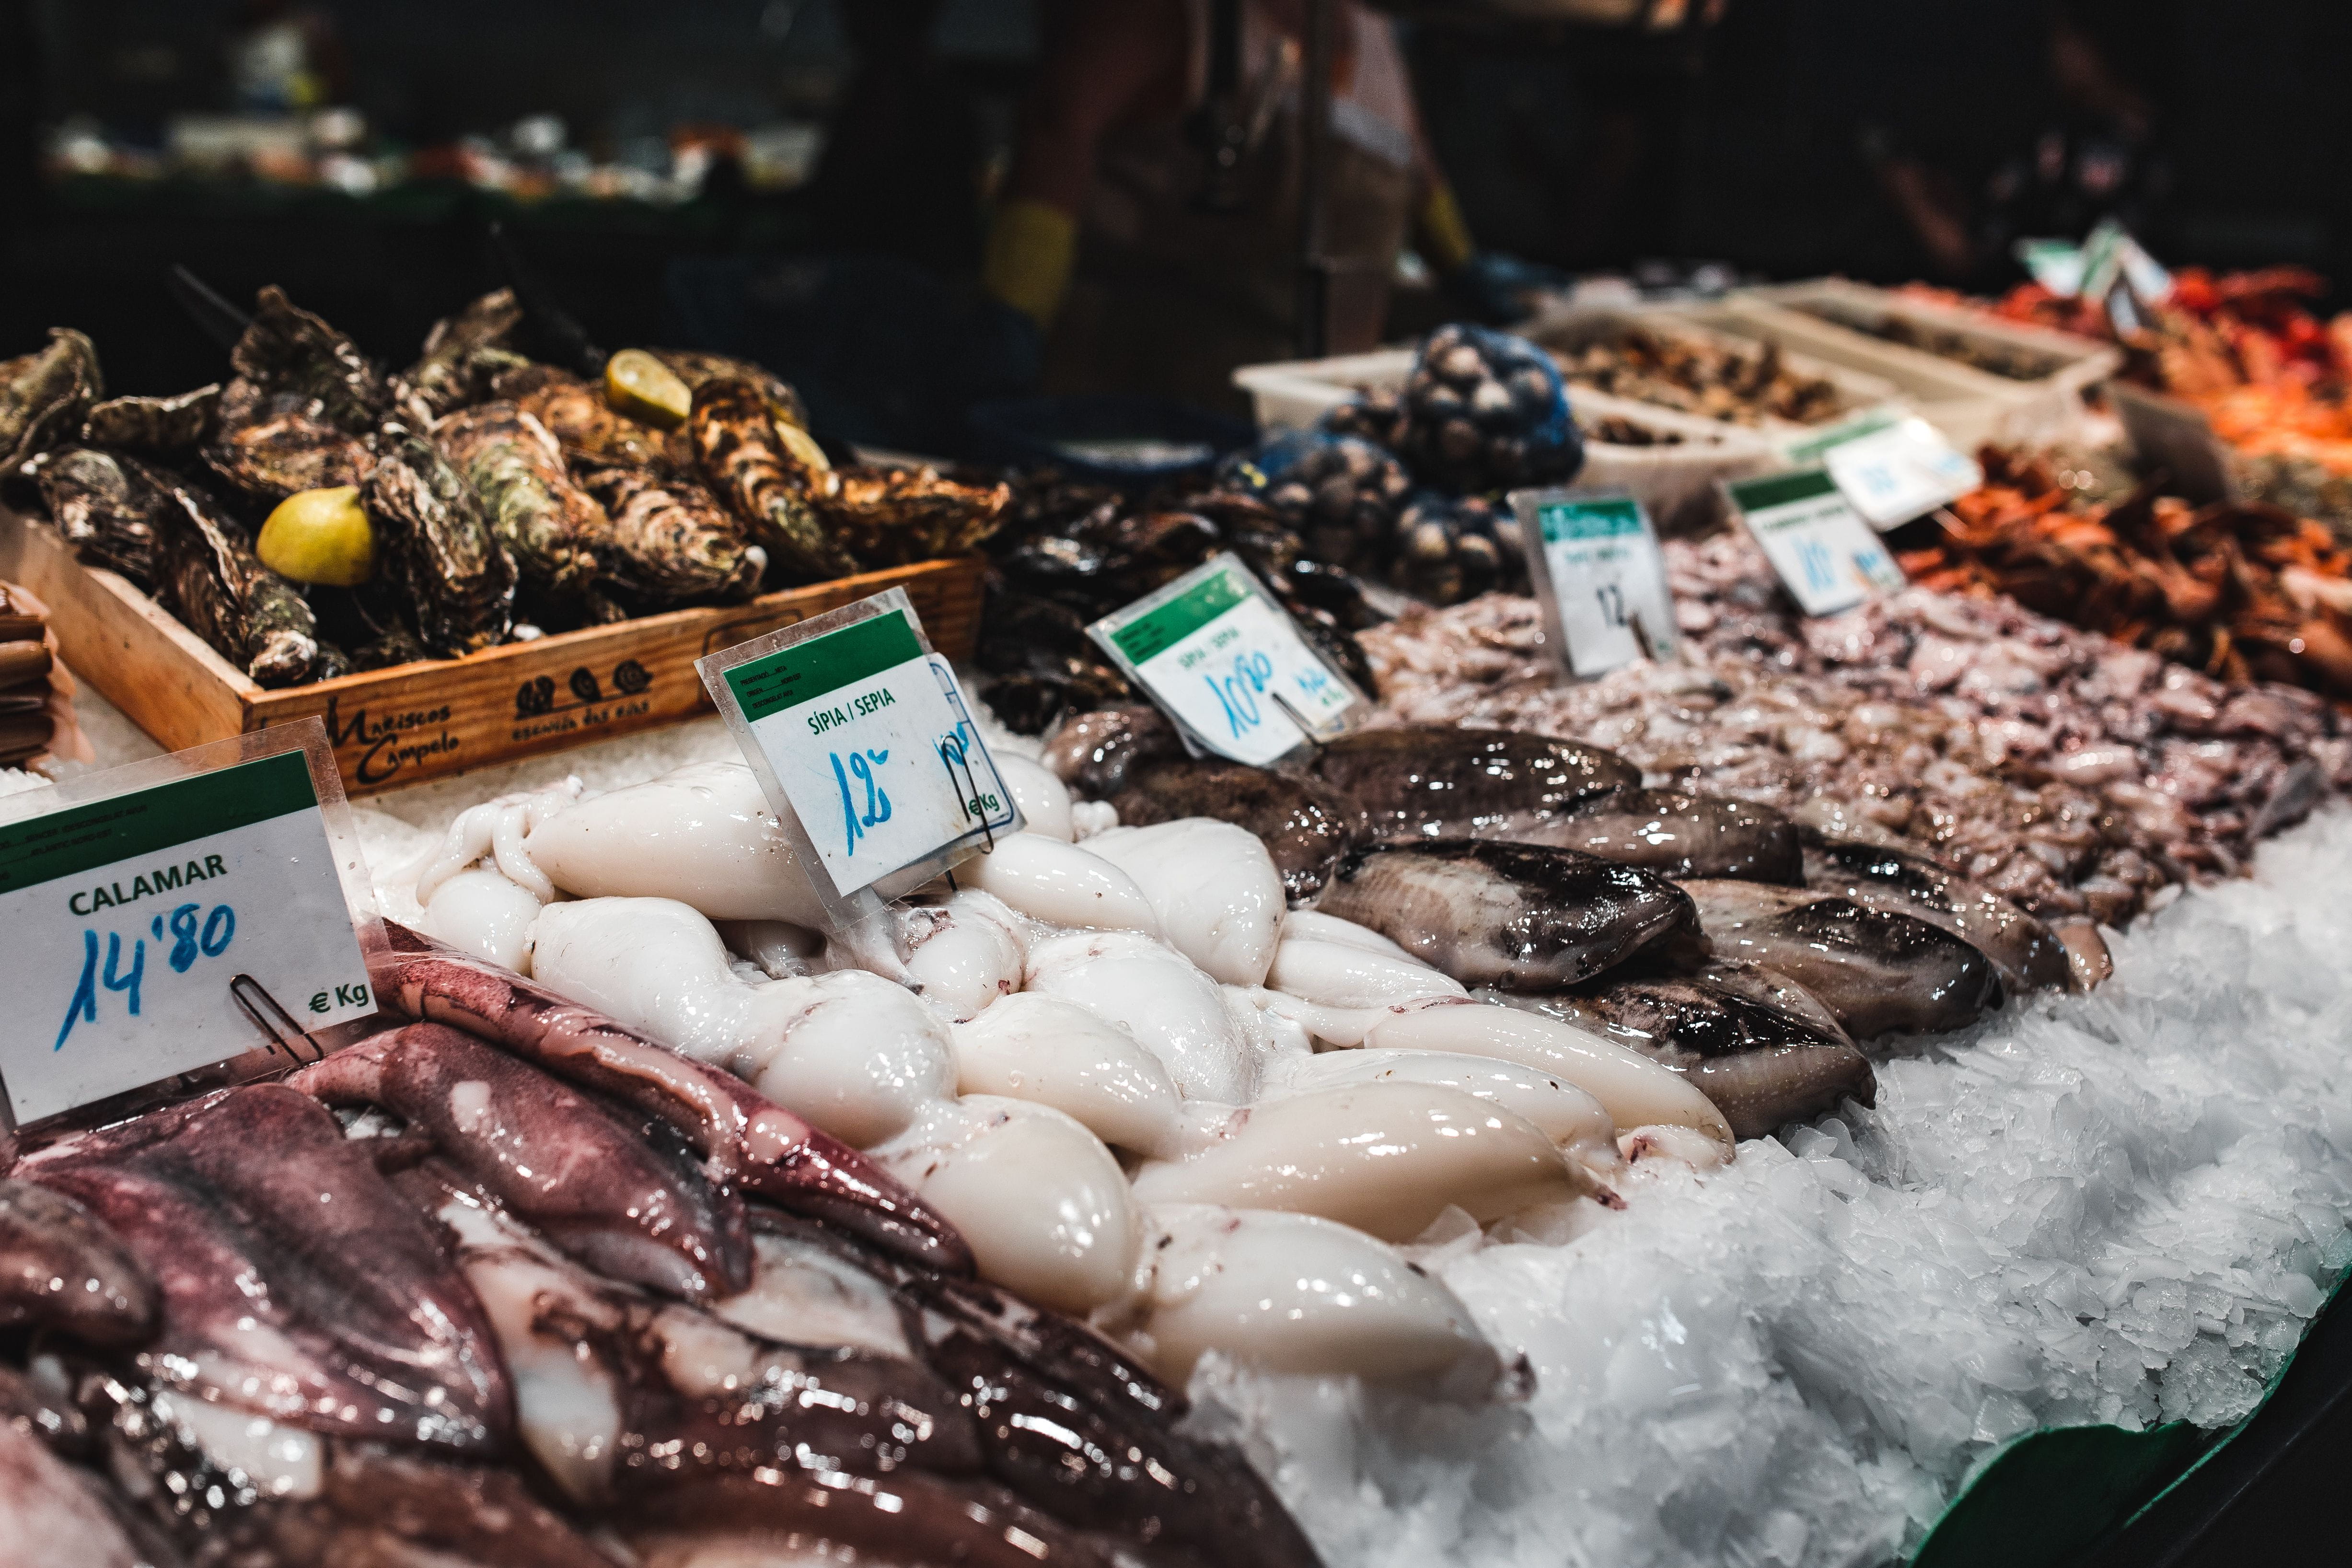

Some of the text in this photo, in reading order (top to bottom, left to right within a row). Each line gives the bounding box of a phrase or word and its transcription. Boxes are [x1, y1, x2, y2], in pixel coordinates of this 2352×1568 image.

[808, 707, 847, 735] SÍPIA
[855, 688, 896, 716] SEPIA
[69, 854, 228, 917] CALAMAR
[308, 983, 370, 1013] € Kg
